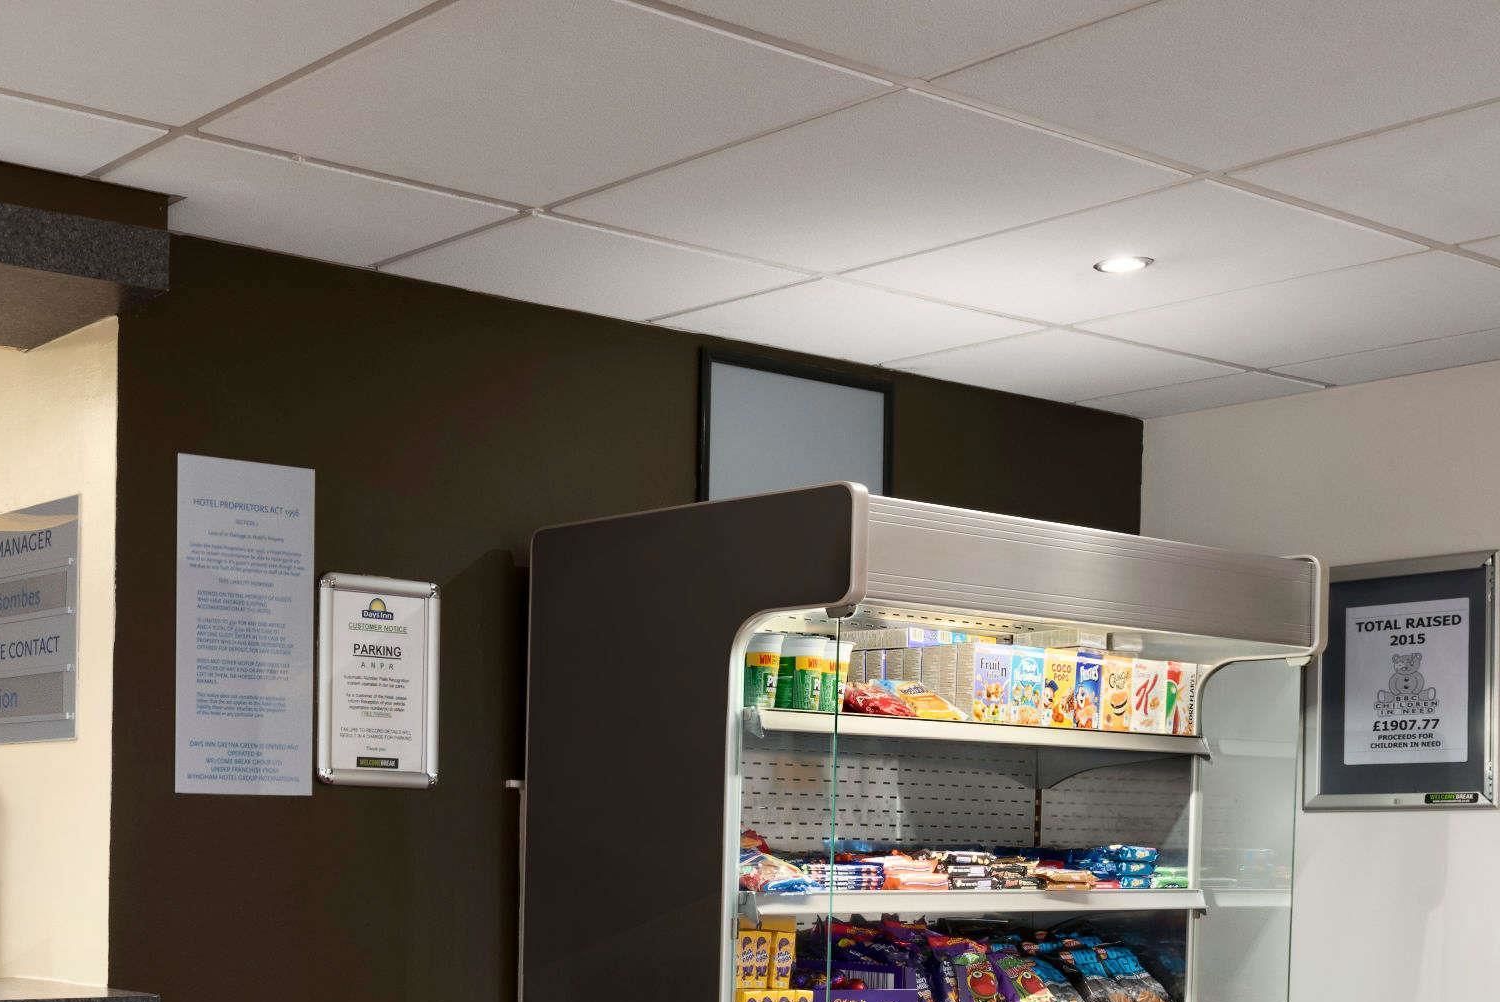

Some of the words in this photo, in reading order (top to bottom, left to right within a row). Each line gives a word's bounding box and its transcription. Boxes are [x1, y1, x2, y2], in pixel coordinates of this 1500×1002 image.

[348, 621, 382, 631] CUSTOMER
[383, 625, 408, 633] NOTICE
[1355, 619, 1402, 633] TOTAL
[1405, 614, 1462, 629] RAISED
[1390, 633, 1426, 646] 2015
[8, 635, 60, 659] CONTACT
[353, 643, 402, 658] PARKING
[1051, 663, 1072, 673] COCO
[1372, 718, 1440, 732] £1907.77
[1377, 733, 1417, 741] PROCEEDS
[1418, 732, 1434, 740] FOR
[1370, 741, 1408, 749] CHILDREN
[1421, 740, 1441, 748] NEED
